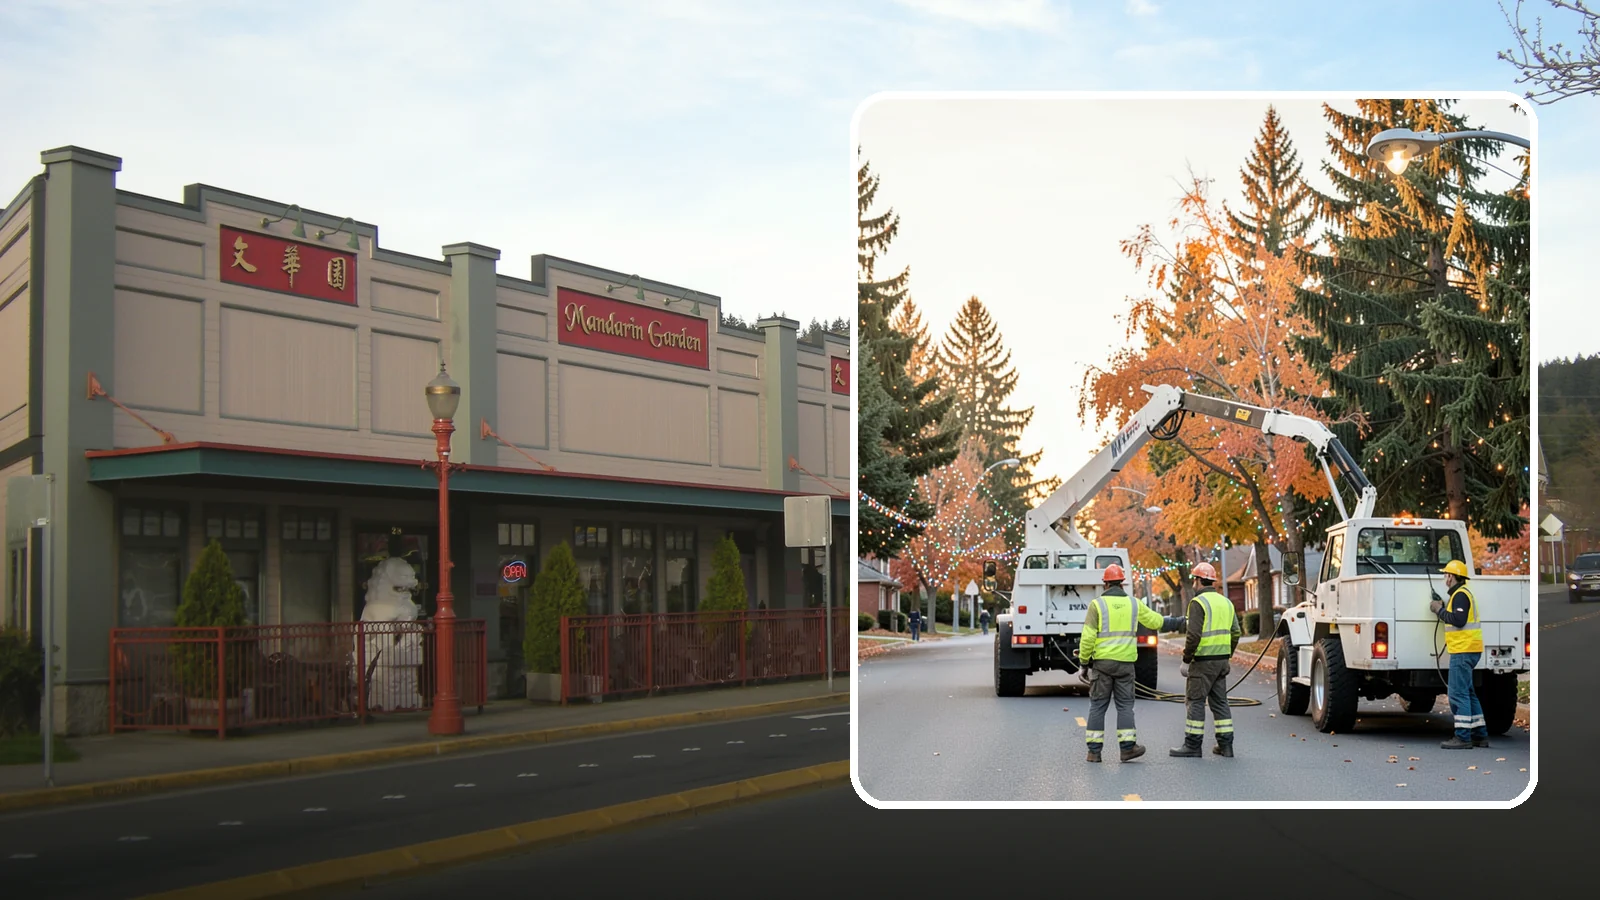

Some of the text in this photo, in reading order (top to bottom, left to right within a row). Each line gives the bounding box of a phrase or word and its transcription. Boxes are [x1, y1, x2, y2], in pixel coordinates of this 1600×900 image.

[231, 236, 346, 291] 文華園
[564, 302, 701, 352] Mandarin Garden
[503, 565, 527, 578] OPEN
